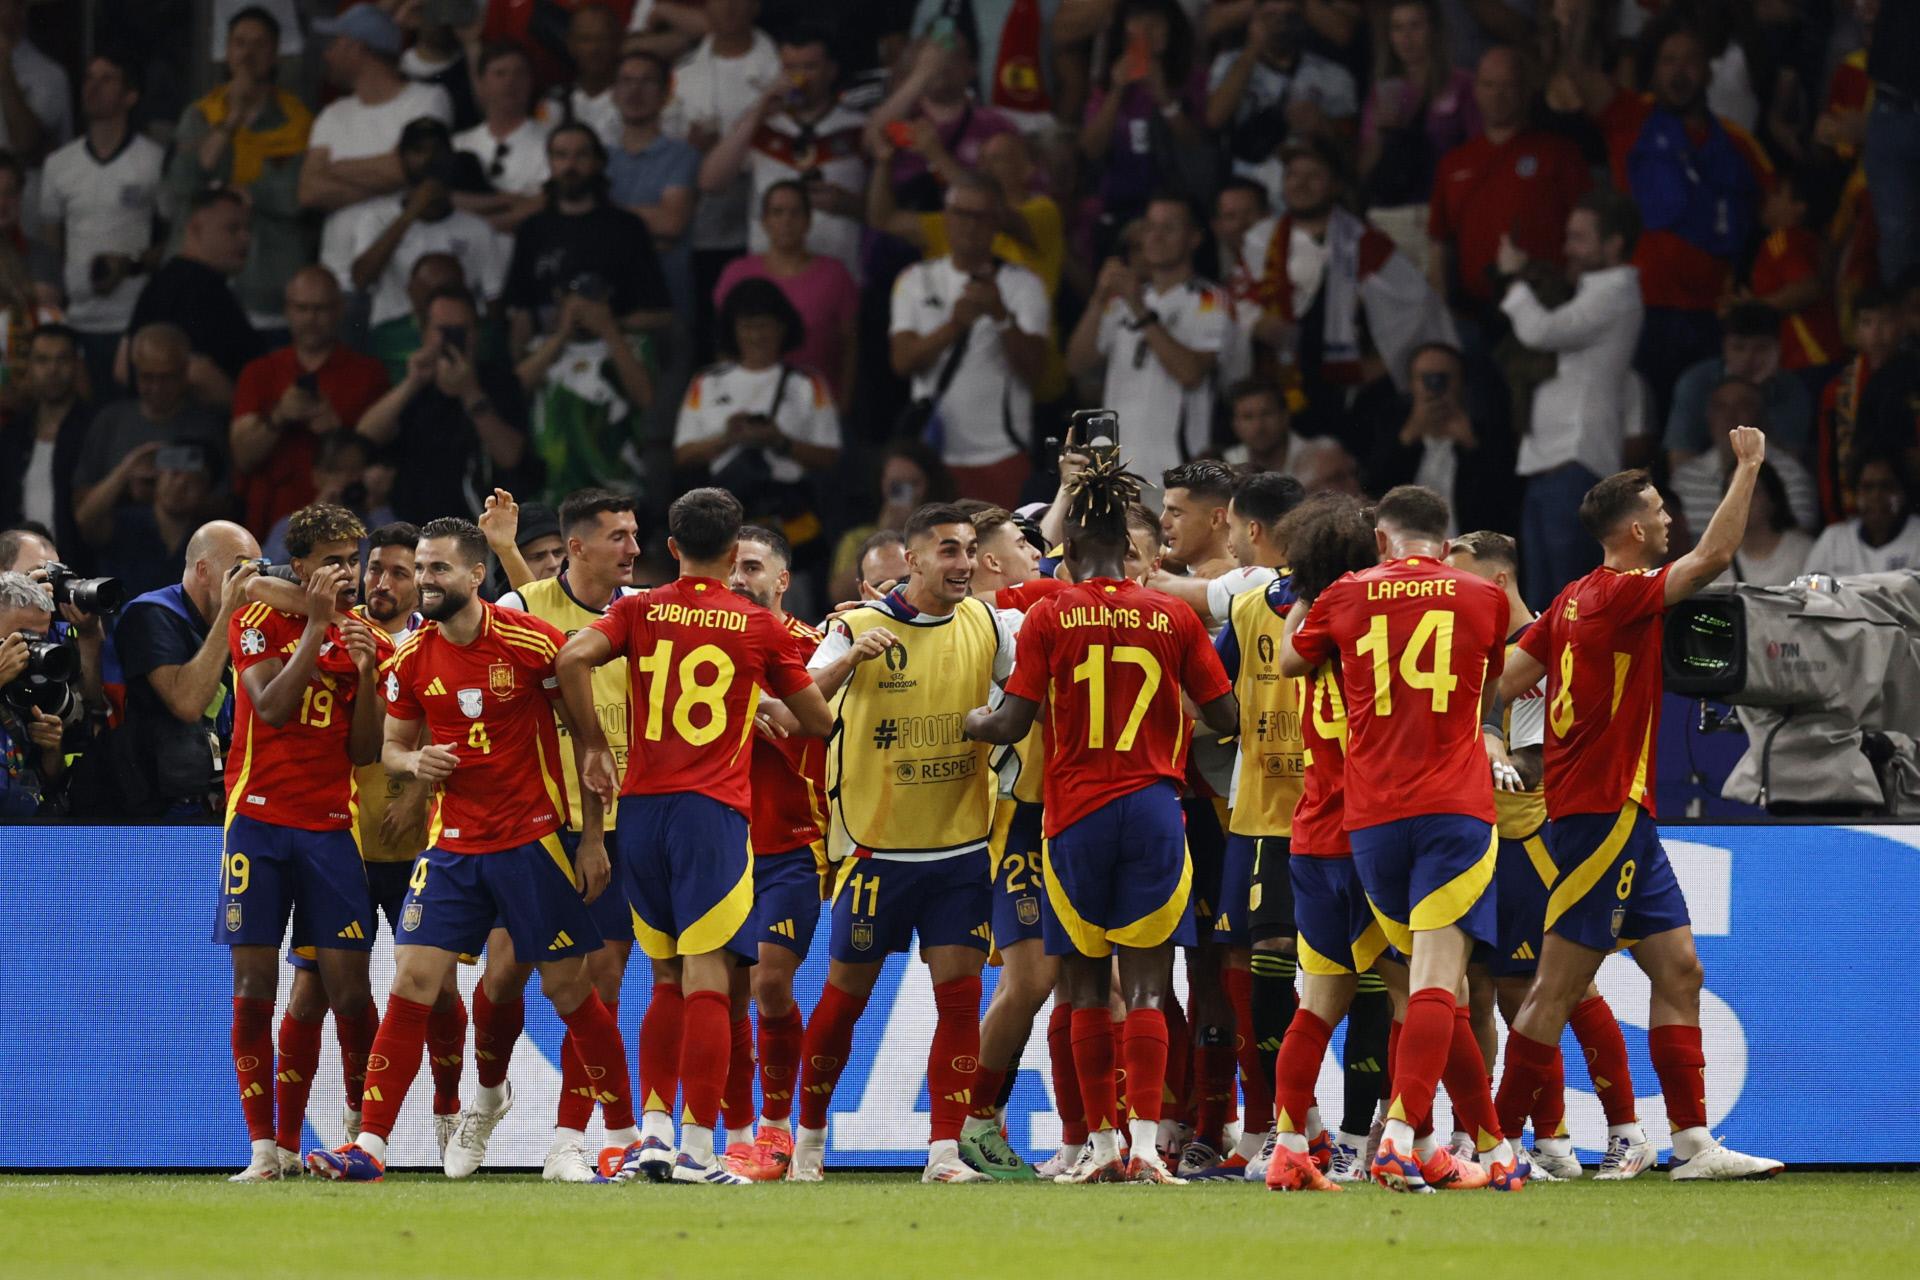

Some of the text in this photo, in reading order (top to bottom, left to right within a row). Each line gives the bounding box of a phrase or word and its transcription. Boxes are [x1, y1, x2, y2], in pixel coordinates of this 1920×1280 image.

[1367, 579, 1457, 601] LAPORTE
[646, 603, 748, 633] ZUBIMENDI
[1059, 606, 1173, 635] WILLIAMS JR.
[1355, 609, 1458, 716] 14
[300, 685, 335, 728] 19
[638, 639, 736, 747] 18
[1073, 644, 1162, 751] 17
[1549, 640, 1576, 739] 8
[467, 721, 491, 755] 4
[873, 712, 968, 750] #FOOTB
[921, 756, 977, 779] RESPECT
[224, 852, 251, 896] 19
[409, 857, 430, 897] 4
[849, 872, 881, 918] 11
[1616, 859, 1636, 901] 8
